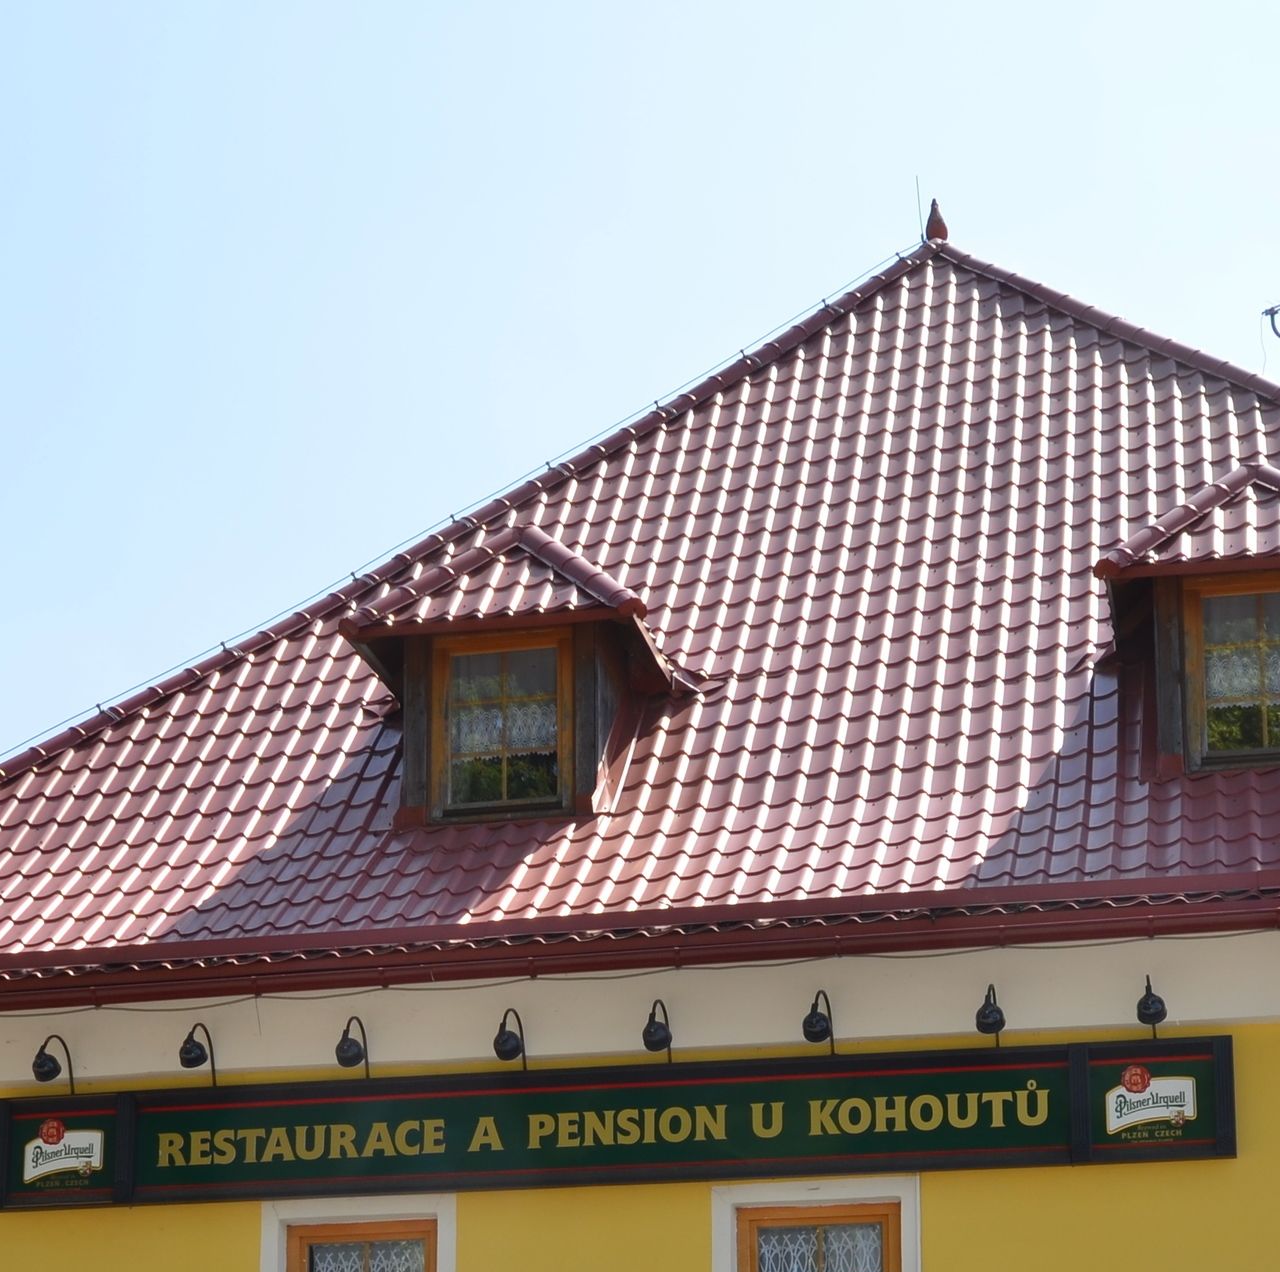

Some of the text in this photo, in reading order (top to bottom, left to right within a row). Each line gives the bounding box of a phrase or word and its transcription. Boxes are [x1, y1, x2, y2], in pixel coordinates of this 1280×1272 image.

[1114, 1091, 1186, 1119] Pilsner Urquell
[156, 1079, 1051, 1169] RESTAURACE A PENSION U KOHOUTŮ
[31, 1142, 94, 1169] Pilsner Urquell
